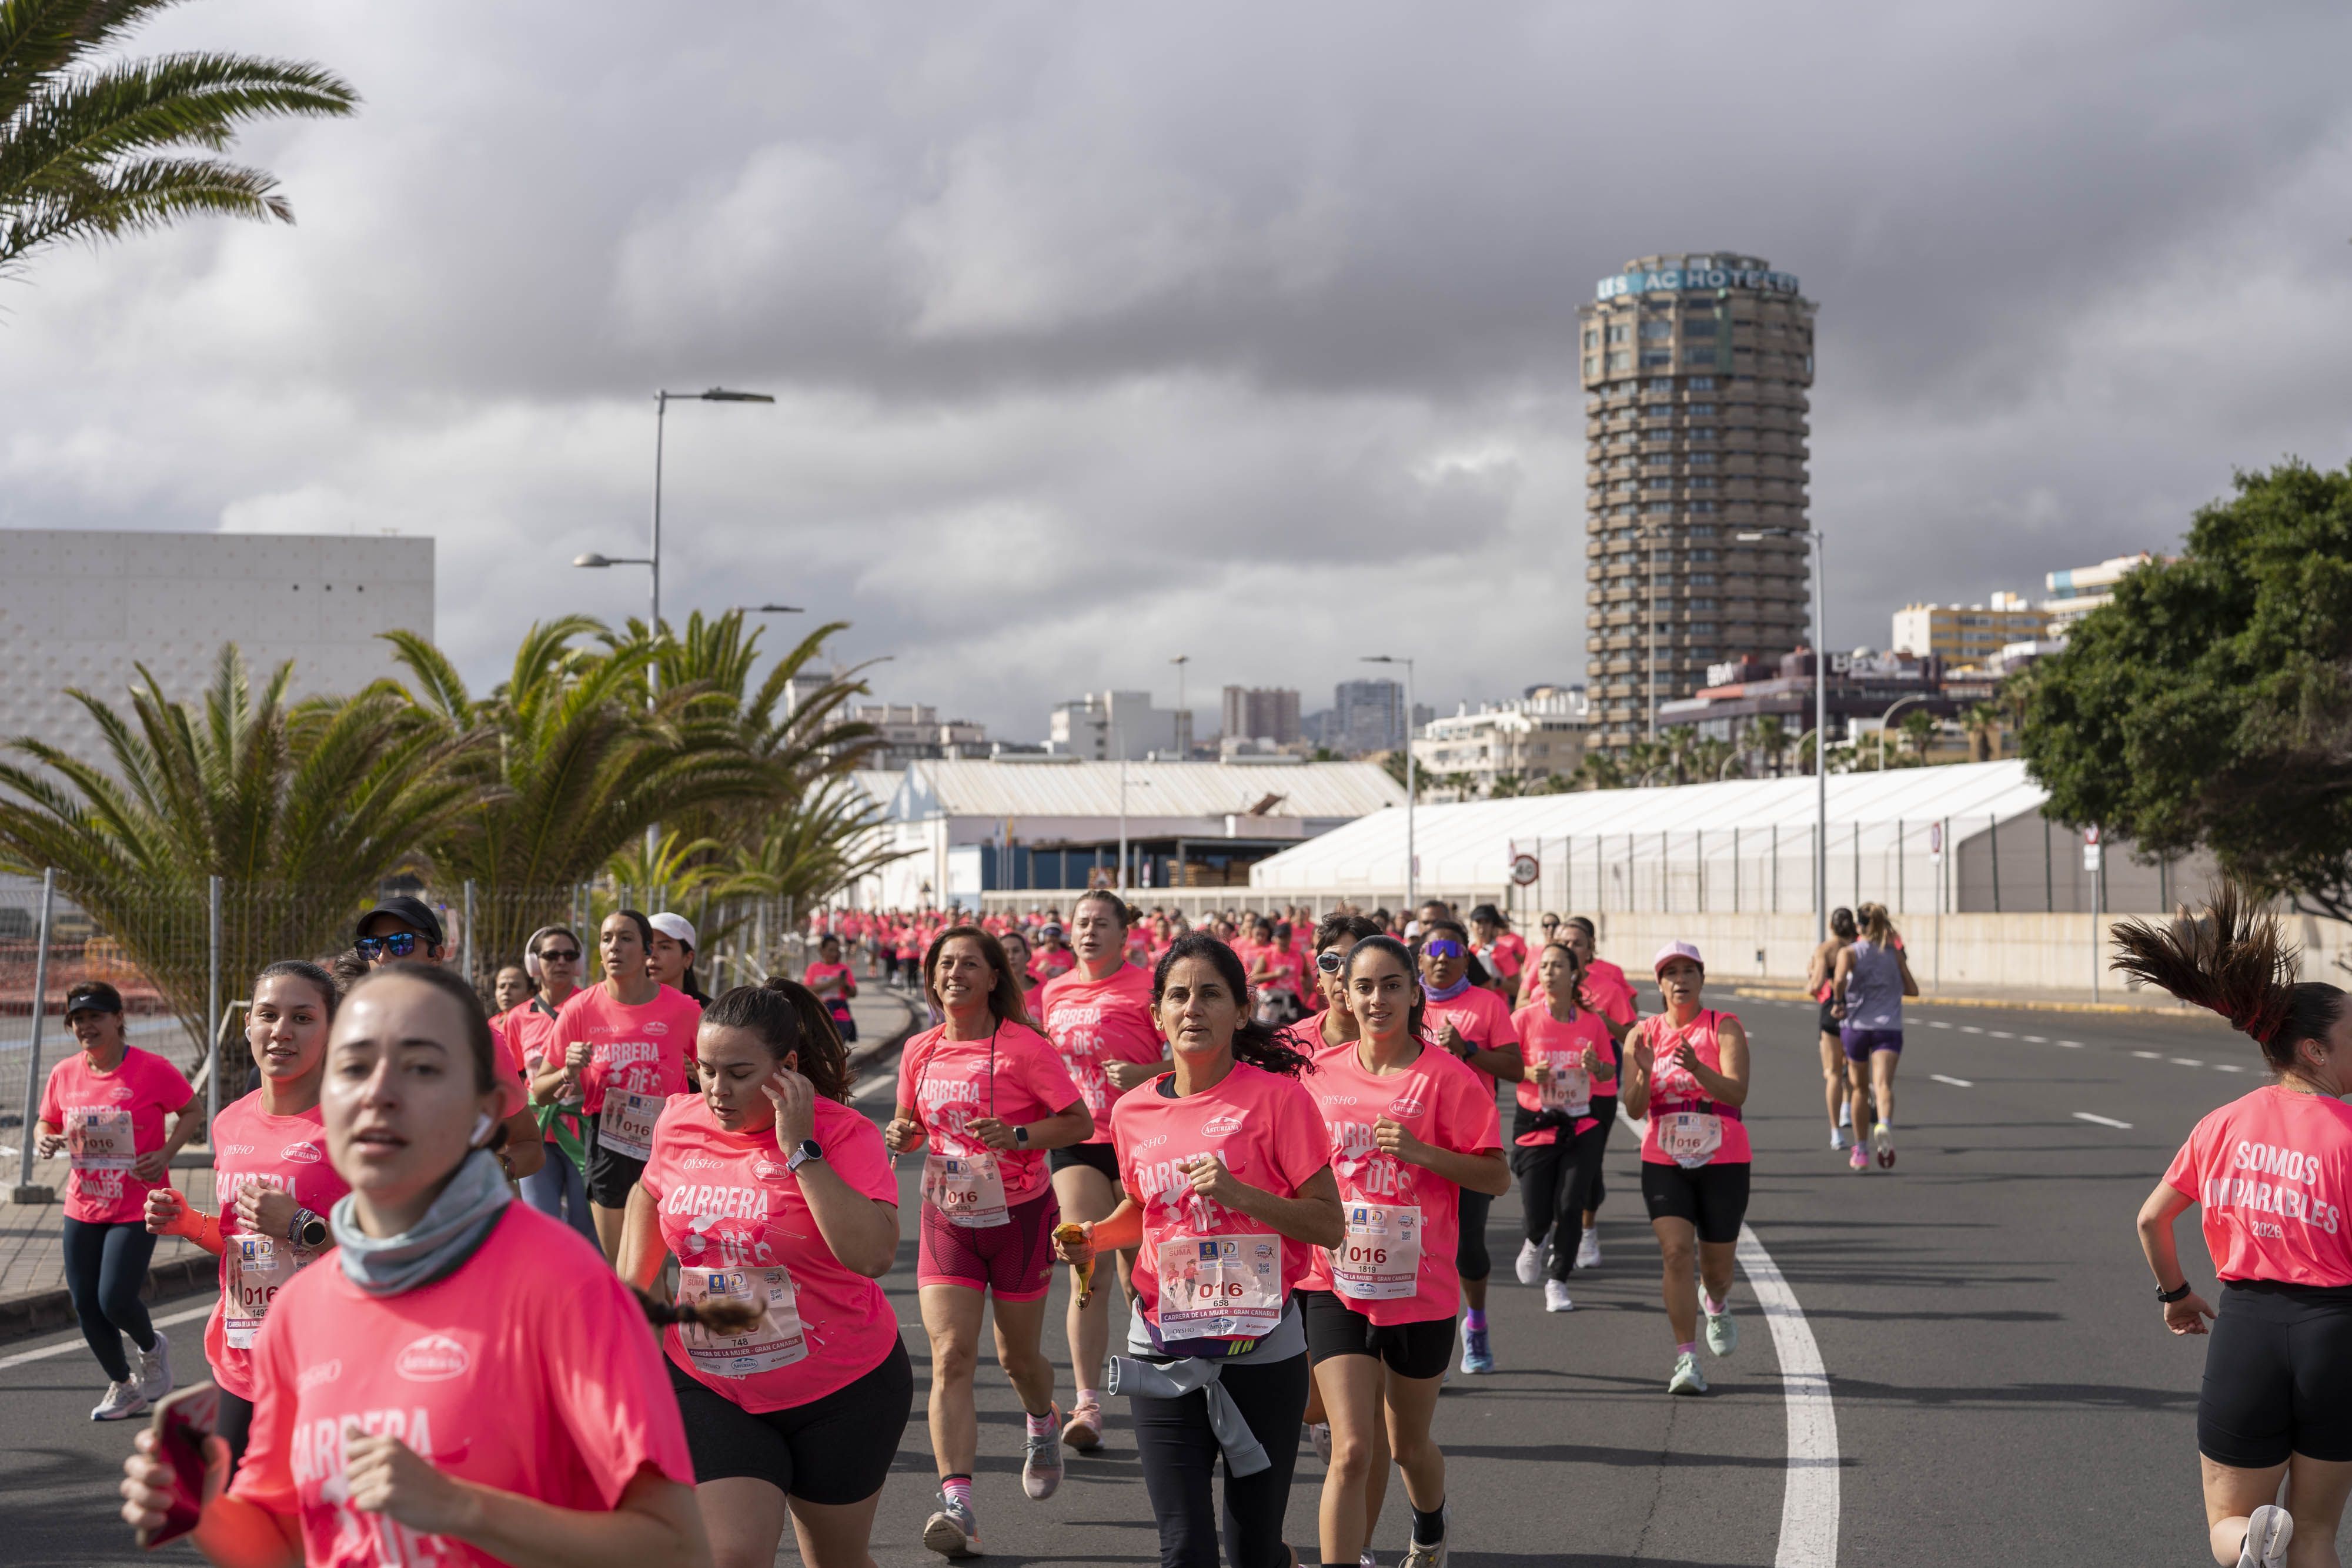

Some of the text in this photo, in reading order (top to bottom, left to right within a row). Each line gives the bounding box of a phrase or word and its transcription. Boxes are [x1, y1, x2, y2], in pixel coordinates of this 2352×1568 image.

[1646, 271, 1678, 290] AC
[593, 1042, 659, 1063] CARRERA
[1322, 1095, 1357, 1105] OYSHO
[1558, 1090, 1576, 1098] 016
[623, 1121, 650, 1136] 016
[1204, 1125, 1239, 1134] ASTURIANA
[89, 1139, 113, 1148] 016
[1134, 1135, 1167, 1156] OYSHO
[1677, 1138, 1700, 1148] 016
[224, 1144, 254, 1157] OYSHO
[283, 1148, 318, 1161] ASTURIANA
[684, 1158, 724, 1169] OYSHO
[2235, 1141, 2319, 1185] SOMOS
[756, 1165, 786, 1176] ASTURIANA
[668, 1185, 769, 1220] CARRERA
[948, 1191, 978, 1203] 016
[2204, 1178, 2340, 1234] IMPARABLES
[2252, 1221, 2282, 1238] 2026
[1350, 1246, 1387, 1263] 016
[1200, 1281, 1243, 1298] 016
[731, 1338, 748, 1347] 748
[772, 1339, 799, 1350] CANARIA
